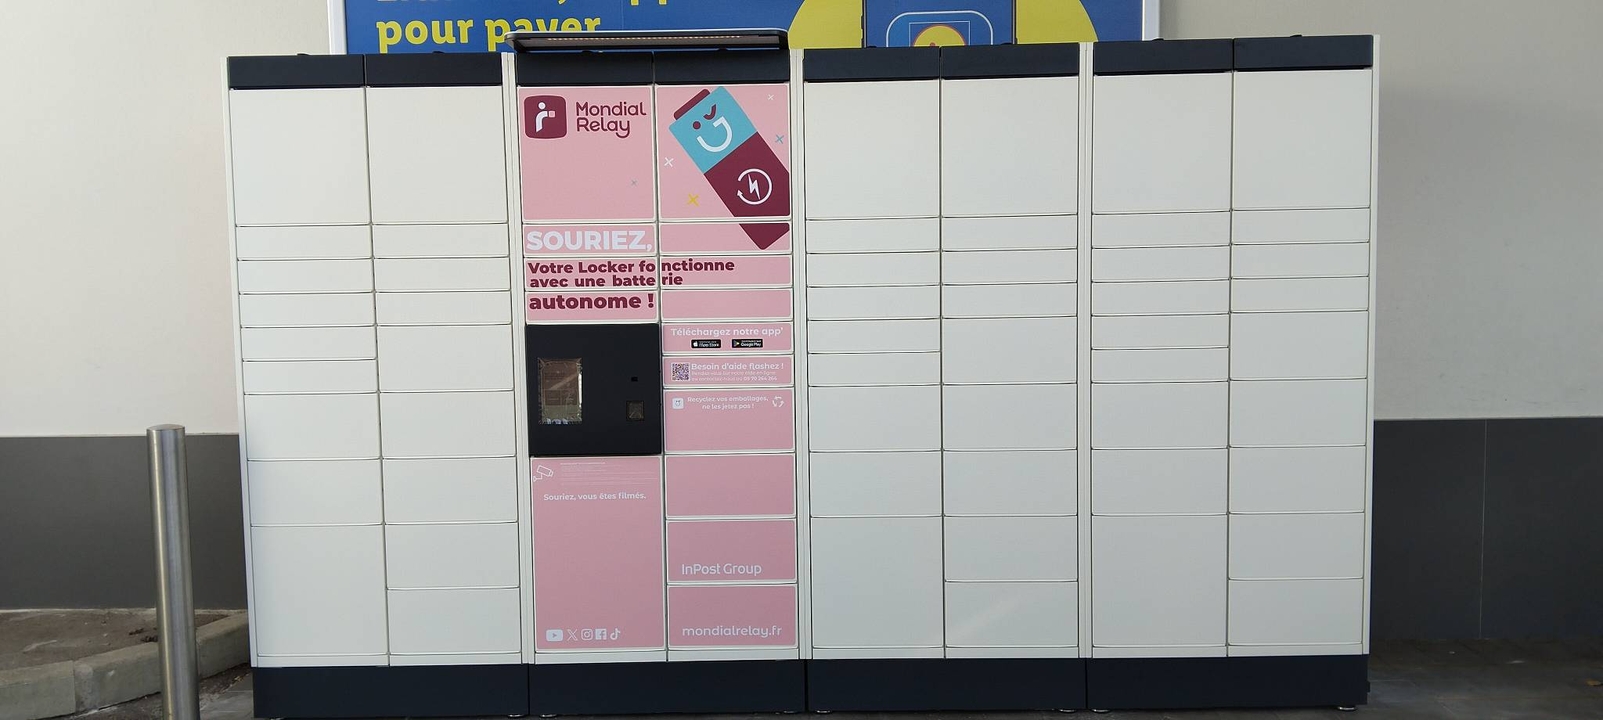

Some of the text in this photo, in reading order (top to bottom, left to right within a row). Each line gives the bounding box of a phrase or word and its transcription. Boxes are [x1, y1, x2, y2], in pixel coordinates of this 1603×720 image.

[376, 18, 474, 53] pour
[576, 101, 647, 117] Mondial
[576, 117, 630, 139] Relay
[526, 230, 653, 252] SOURIEZ,
[528, 262, 574, 274] Votre
[578, 260, 634, 273] Locker
[529, 277, 569, 288] avec
[574, 277, 606, 288] une
[529, 293, 654, 310] autonome !
[671, 327, 731, 338] Téléchargez
[733, 328, 759, 336] notre
[721, 362, 747, 370] d'aide
[749, 362, 779, 370] flashez
[728, 395, 769, 403] emballages,
[721, 402, 738, 411] jetez
[543, 493, 577, 501] Souriez,
[599, 492, 617, 500] êtes
[618, 491, 647, 500] filmés.
[681, 563, 762, 577] InPost Group
[682, 625, 782, 638] mondialrelay.fr
